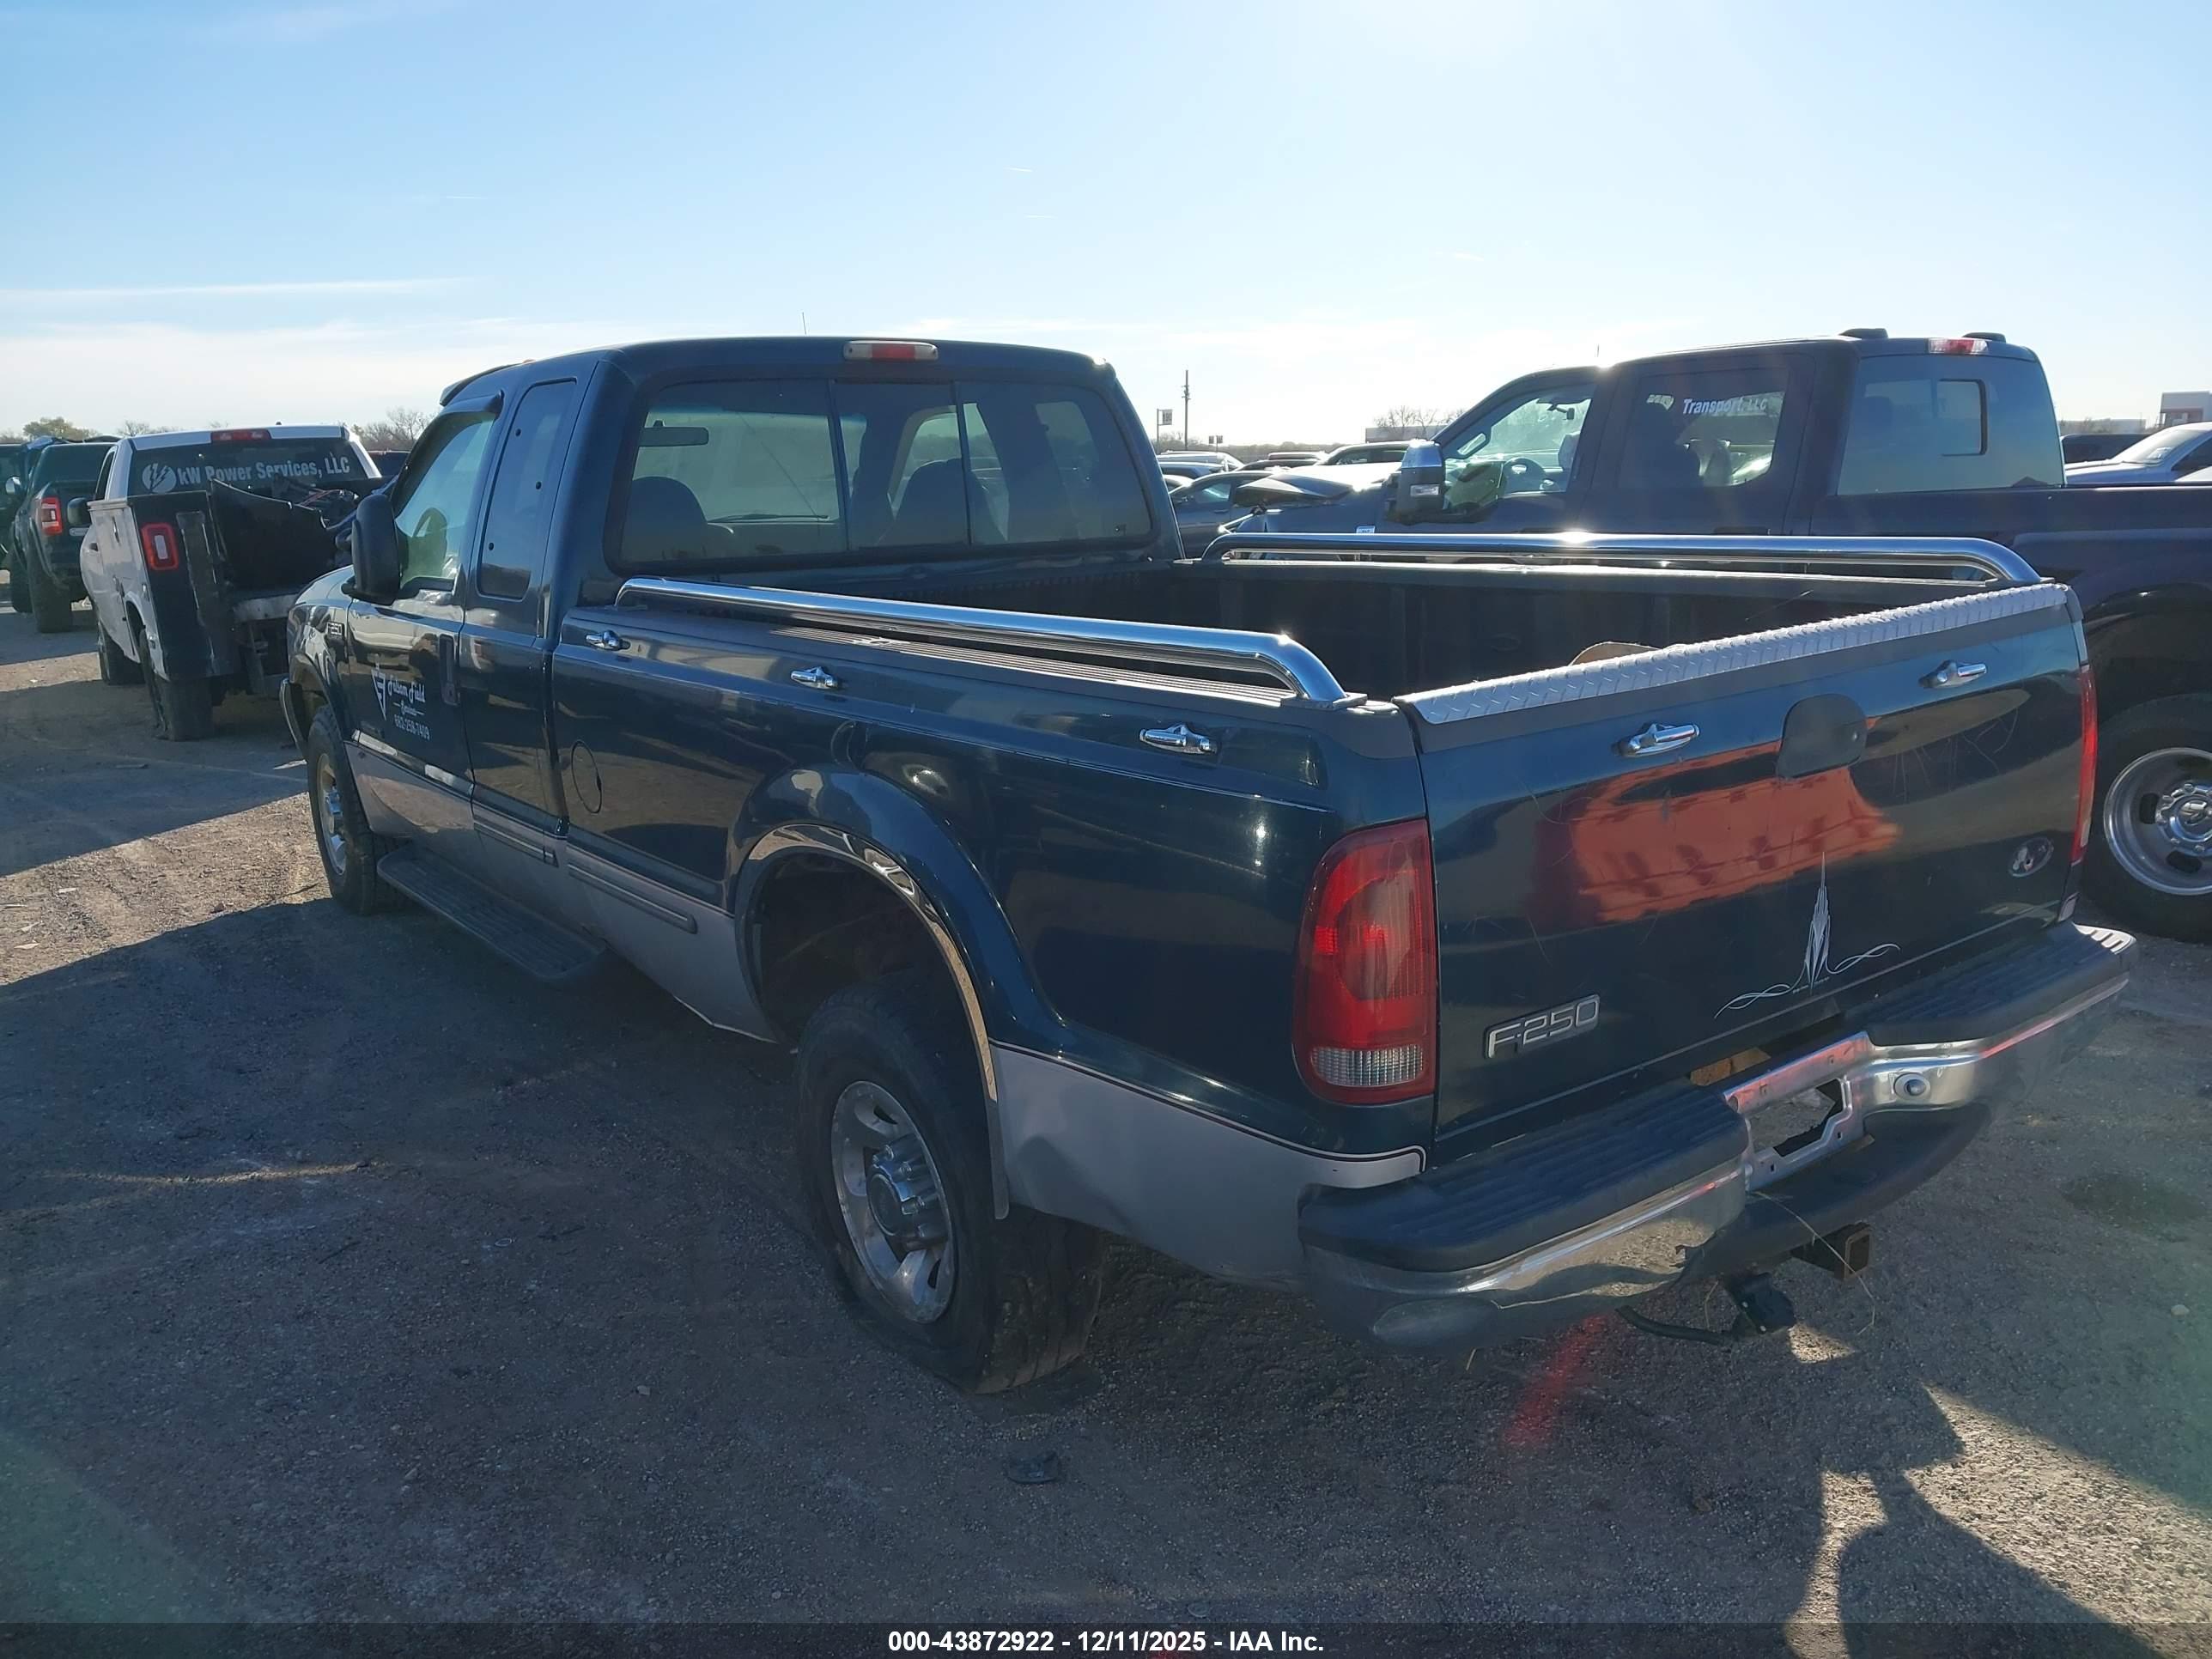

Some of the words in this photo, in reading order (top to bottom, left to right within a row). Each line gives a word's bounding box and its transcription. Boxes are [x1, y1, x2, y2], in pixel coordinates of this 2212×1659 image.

[1747, 398, 1767, 411] LLC
[204, 465, 252, 483] Power
[255, 459, 323, 479] Services,
[324, 454, 350, 474] LLC
